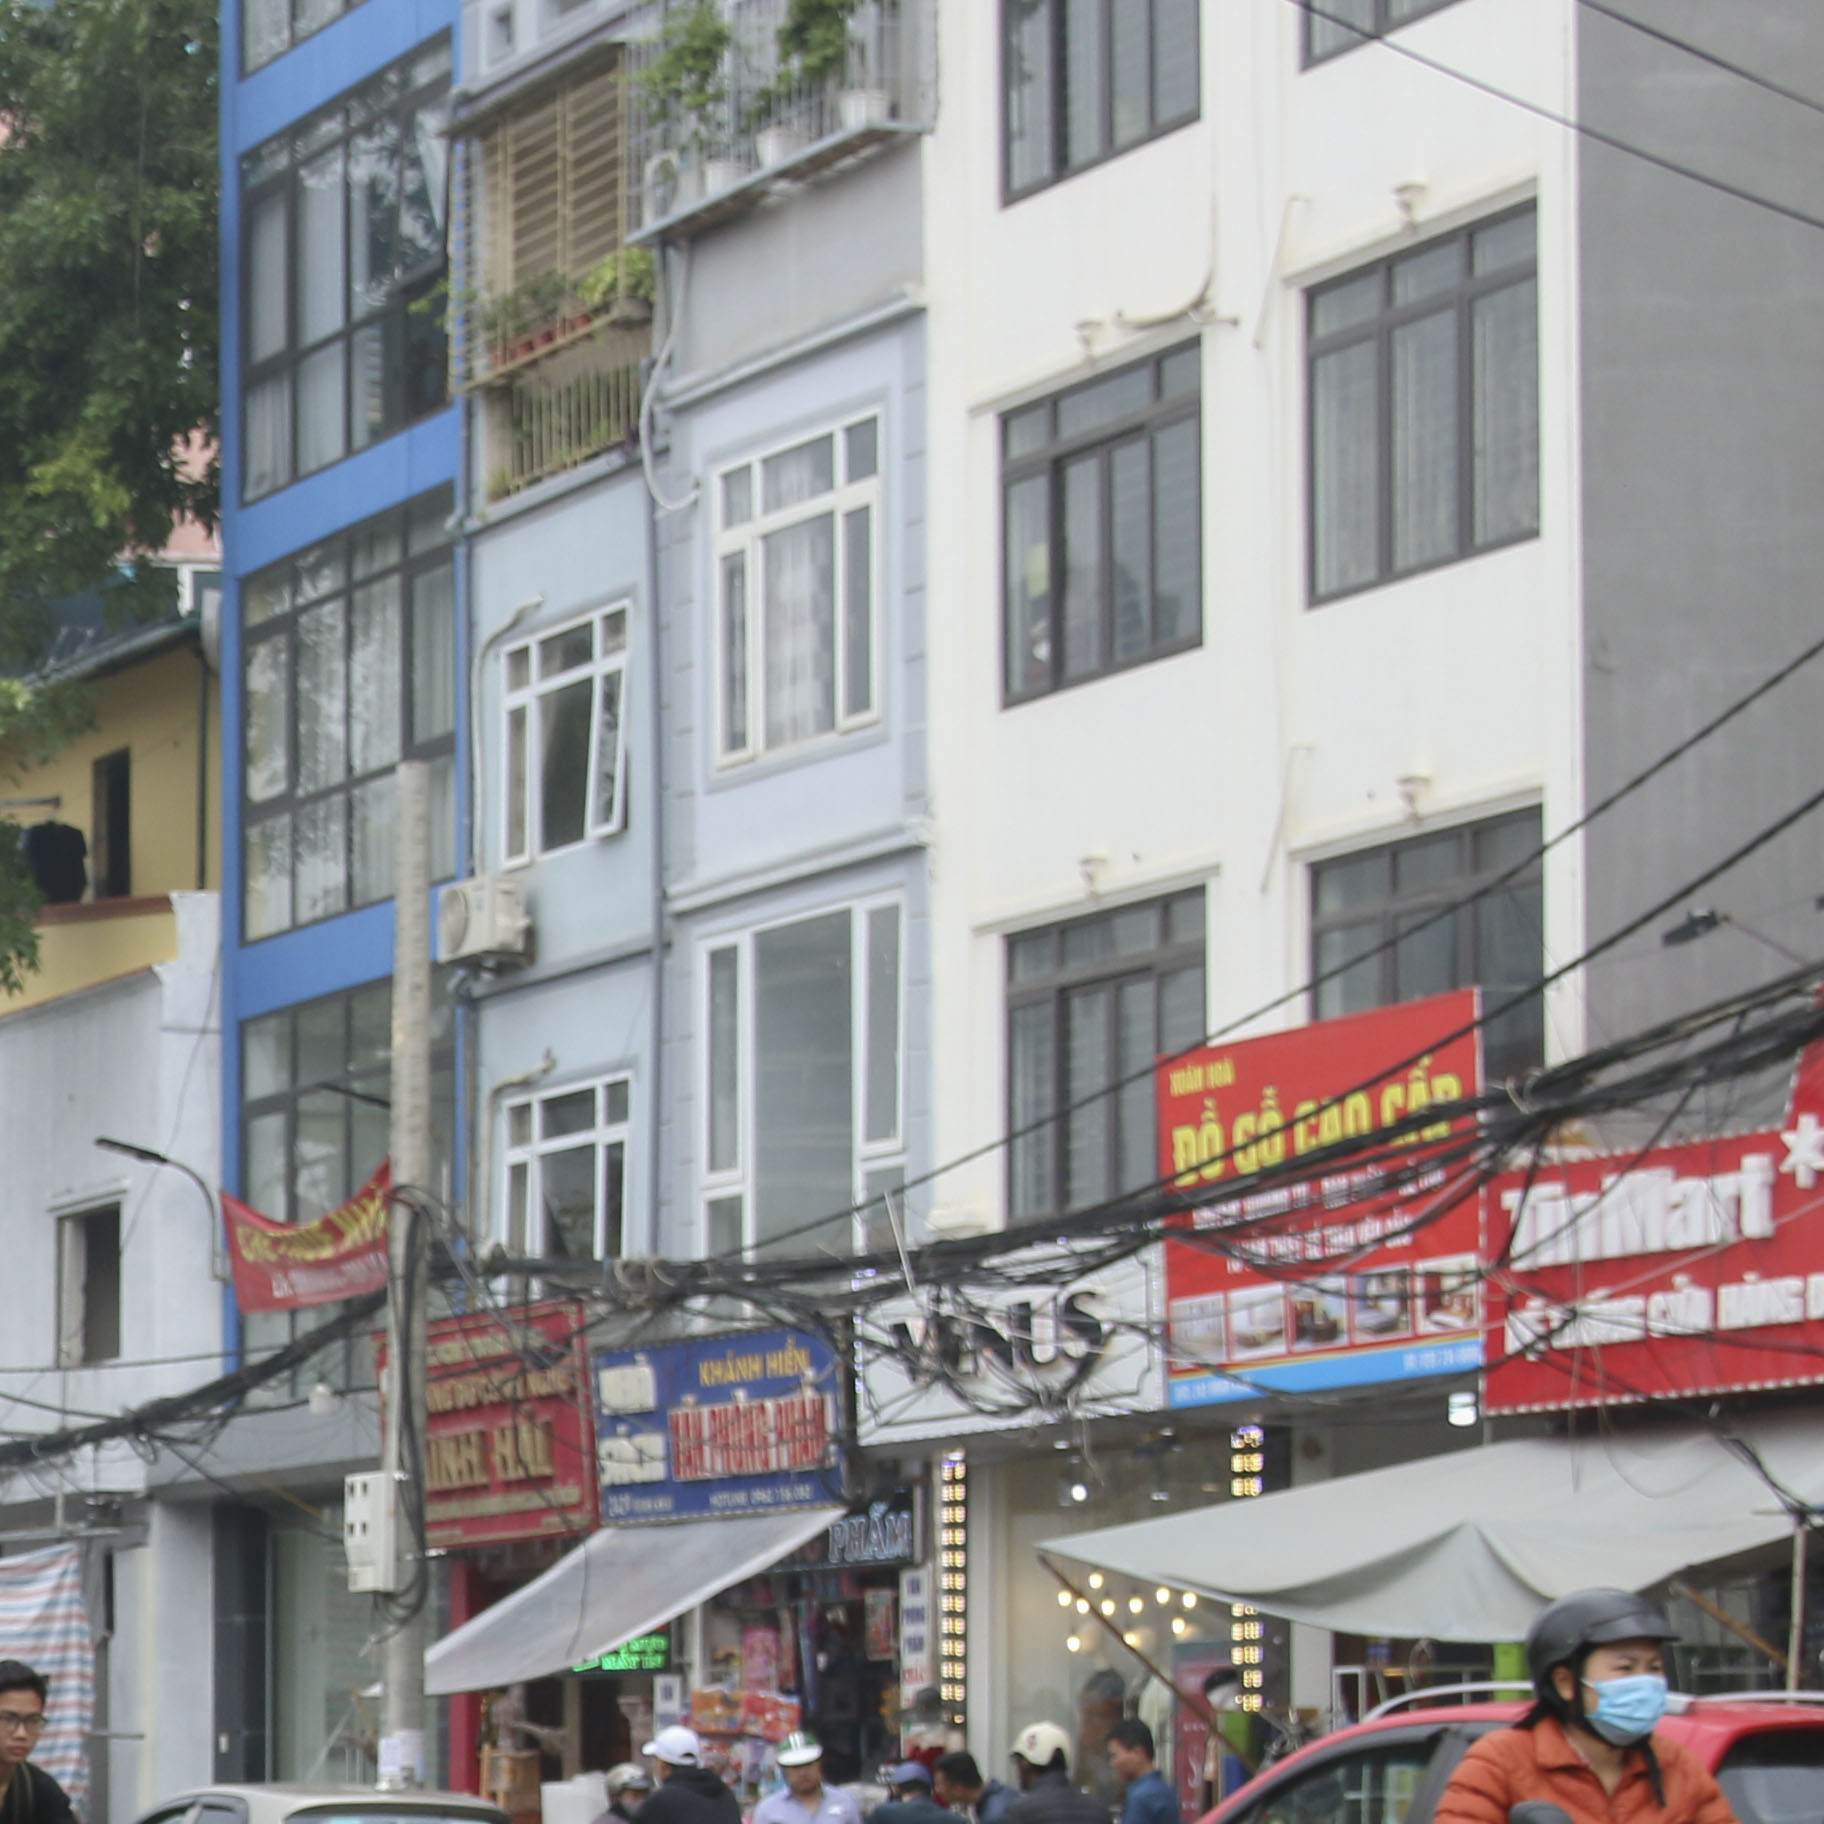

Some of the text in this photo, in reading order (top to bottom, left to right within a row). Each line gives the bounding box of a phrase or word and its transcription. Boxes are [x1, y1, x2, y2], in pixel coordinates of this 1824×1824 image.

[1172, 1096, 1225, 1188] ĐỒ
[1231, 1084, 1286, 1176] GỖ
[1293, 1088, 1372, 1157] CAO
[1716, 1270, 1805, 1330] HÀNG
[828, 1501, 913, 1563] PHẨM
